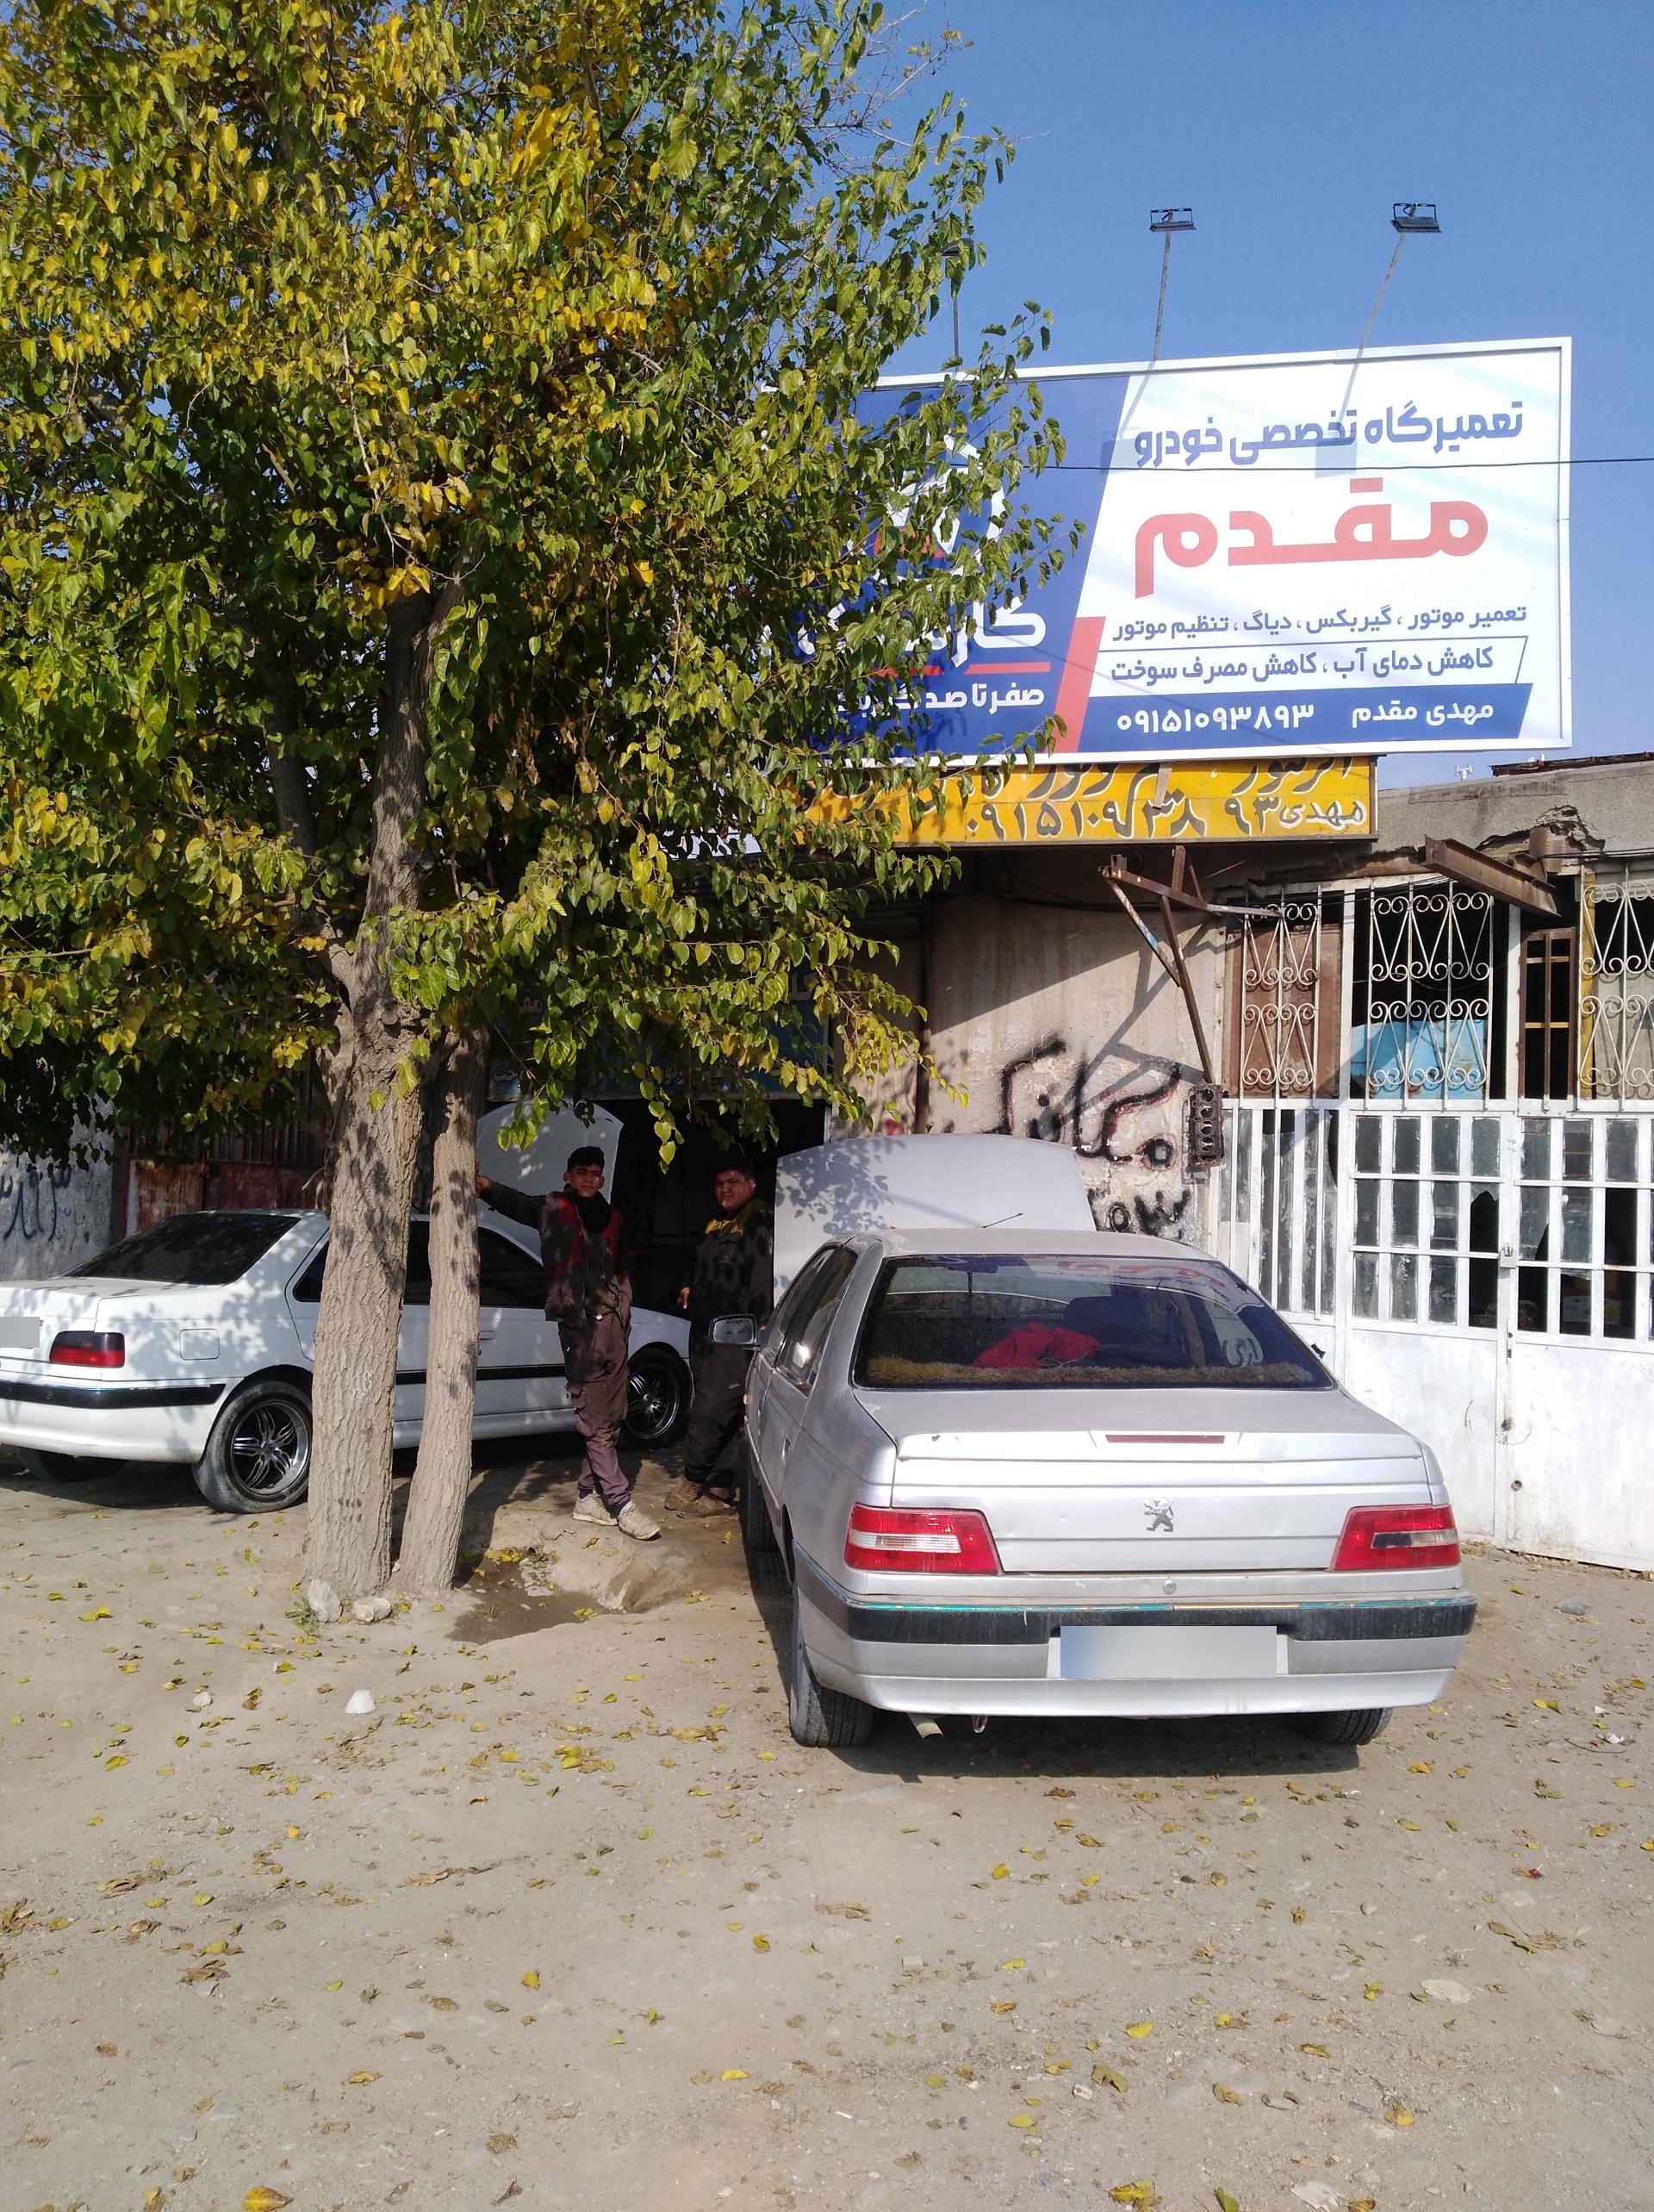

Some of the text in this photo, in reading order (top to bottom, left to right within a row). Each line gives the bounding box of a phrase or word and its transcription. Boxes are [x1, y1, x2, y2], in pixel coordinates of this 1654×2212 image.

[1134, 400, 1523, 469] تعمیرگاه تخصصی خودرو
[1135, 477, 1489, 599] مقدم
[1112, 620, 1167, 642] موتور
[1171, 615, 1229, 639] تنظیم
[1243, 609, 1292, 636] دیاگ
[1306, 605, 1392, 634] گیربکس
[1407, 608, 1464, 631] موتور
[1468, 606, 1527, 629] تعمیر
[1110, 659, 1178, 687] سوخت
[1182, 656, 1248, 685] مصرف
[1253, 650, 1317, 682] کاهش
[1333, 646, 1368, 680] آب
[1372, 650, 1423, 679] دمای
[1427, 645, 1494, 677] کاهش
[1116, 700, 1494, 733] مهدی مقدم ۰۹۱۵۱۰۹۳۸۹۳
[1279, 799, 1365, 831] مهدی
